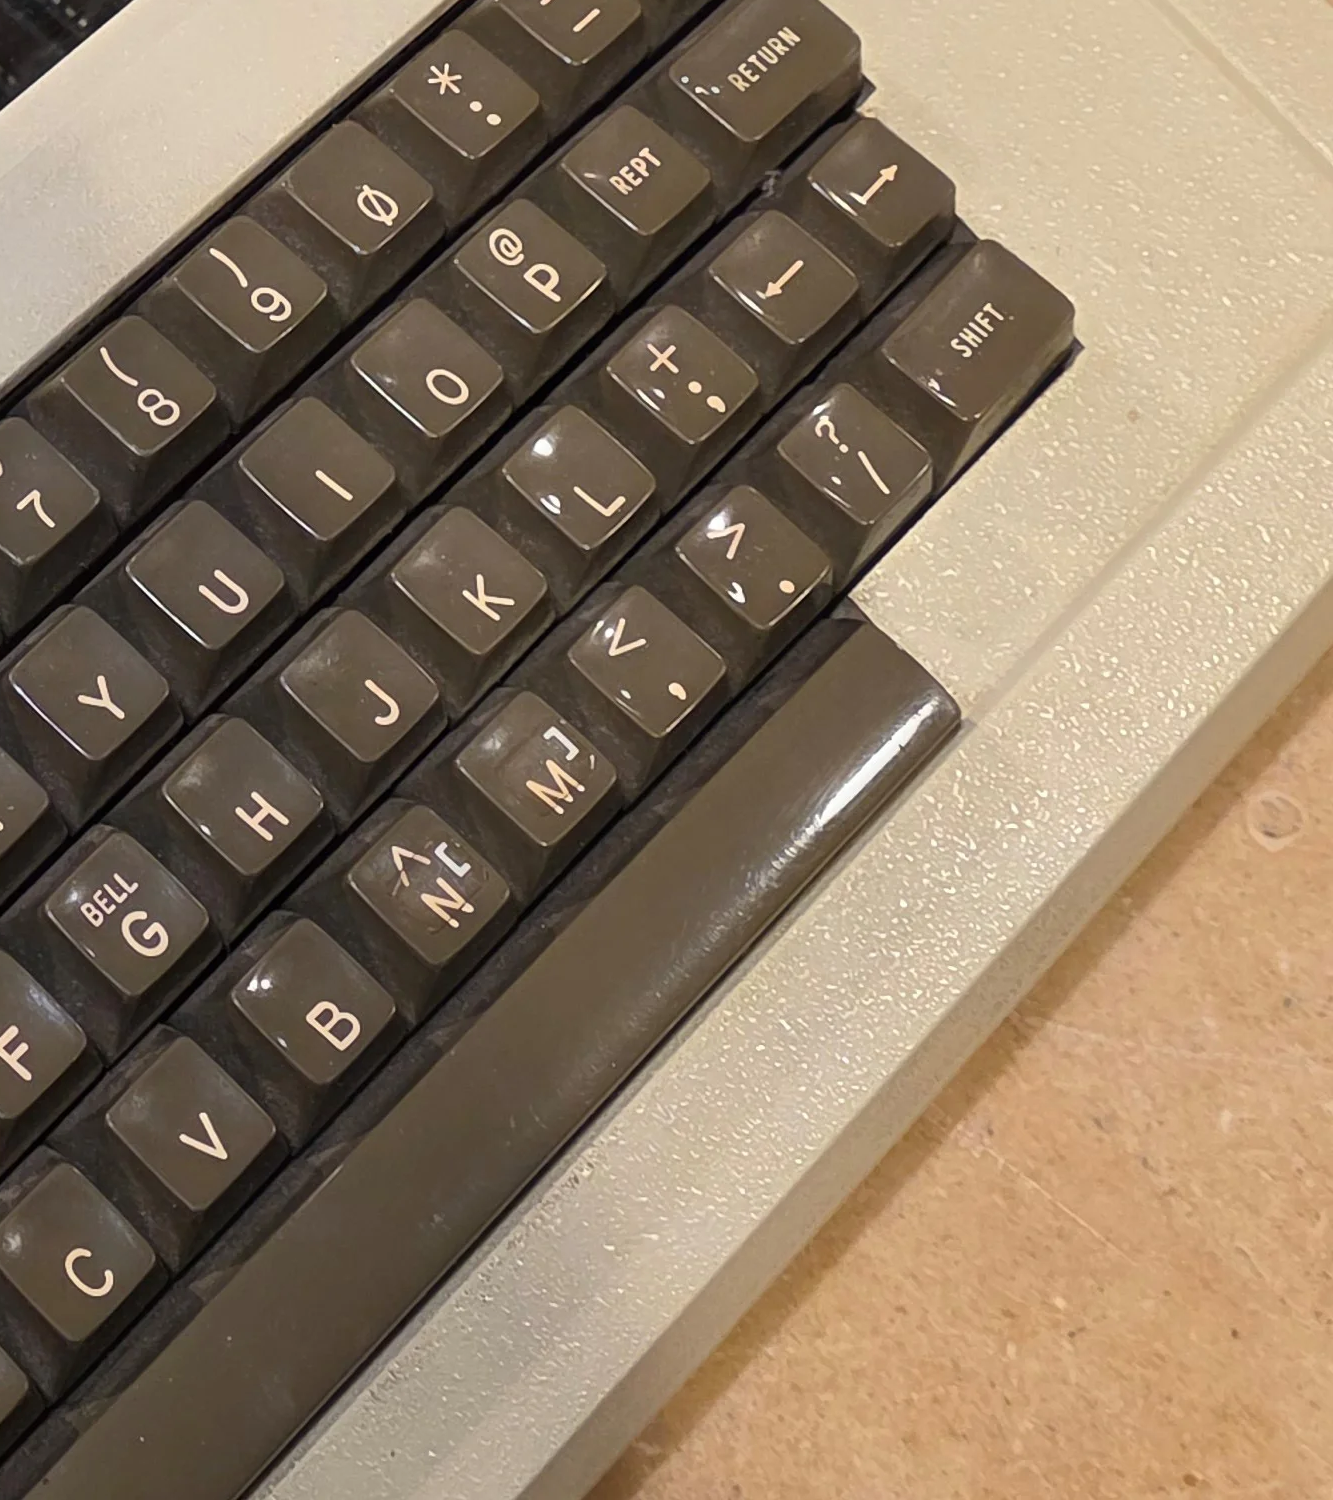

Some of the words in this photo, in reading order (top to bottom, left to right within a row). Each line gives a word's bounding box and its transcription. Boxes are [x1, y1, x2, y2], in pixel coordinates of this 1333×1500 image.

[727, 26, 801, 92] RETURN
[609, 147, 661, 195] REPT
[210, 248, 248, 288] )
[489, 228, 524, 266] @
[251, 286, 292, 322] 9
[524, 263, 561, 302] P
[951, 302, 1004, 358] SHIFT
[100, 347, 138, 386] (
[647, 343, 679, 373] +
[137, 389, 179, 426] 8
[426, 368, 469, 406] O
[687, 381, 726, 412] ;
[815, 416, 849, 453] ?
[858, 451, 890, 494] /
[16, 489, 56, 528] 7
[574, 486, 625, 517] L
[198, 569, 250, 614] U
[463, 574, 515, 621] K
[78, 675, 125, 720] Y
[365, 679, 400, 726] J
[526, 760, 585, 814] M
[235, 791, 290, 841] H
[80, 873, 139, 928] BELL
[420, 877, 475, 929] N
[121, 911, 169, 957] G
[305, 1001, 361, 1051] B
[179, 1112, 228, 1160] V
[65, 1247, 114, 1297] C
